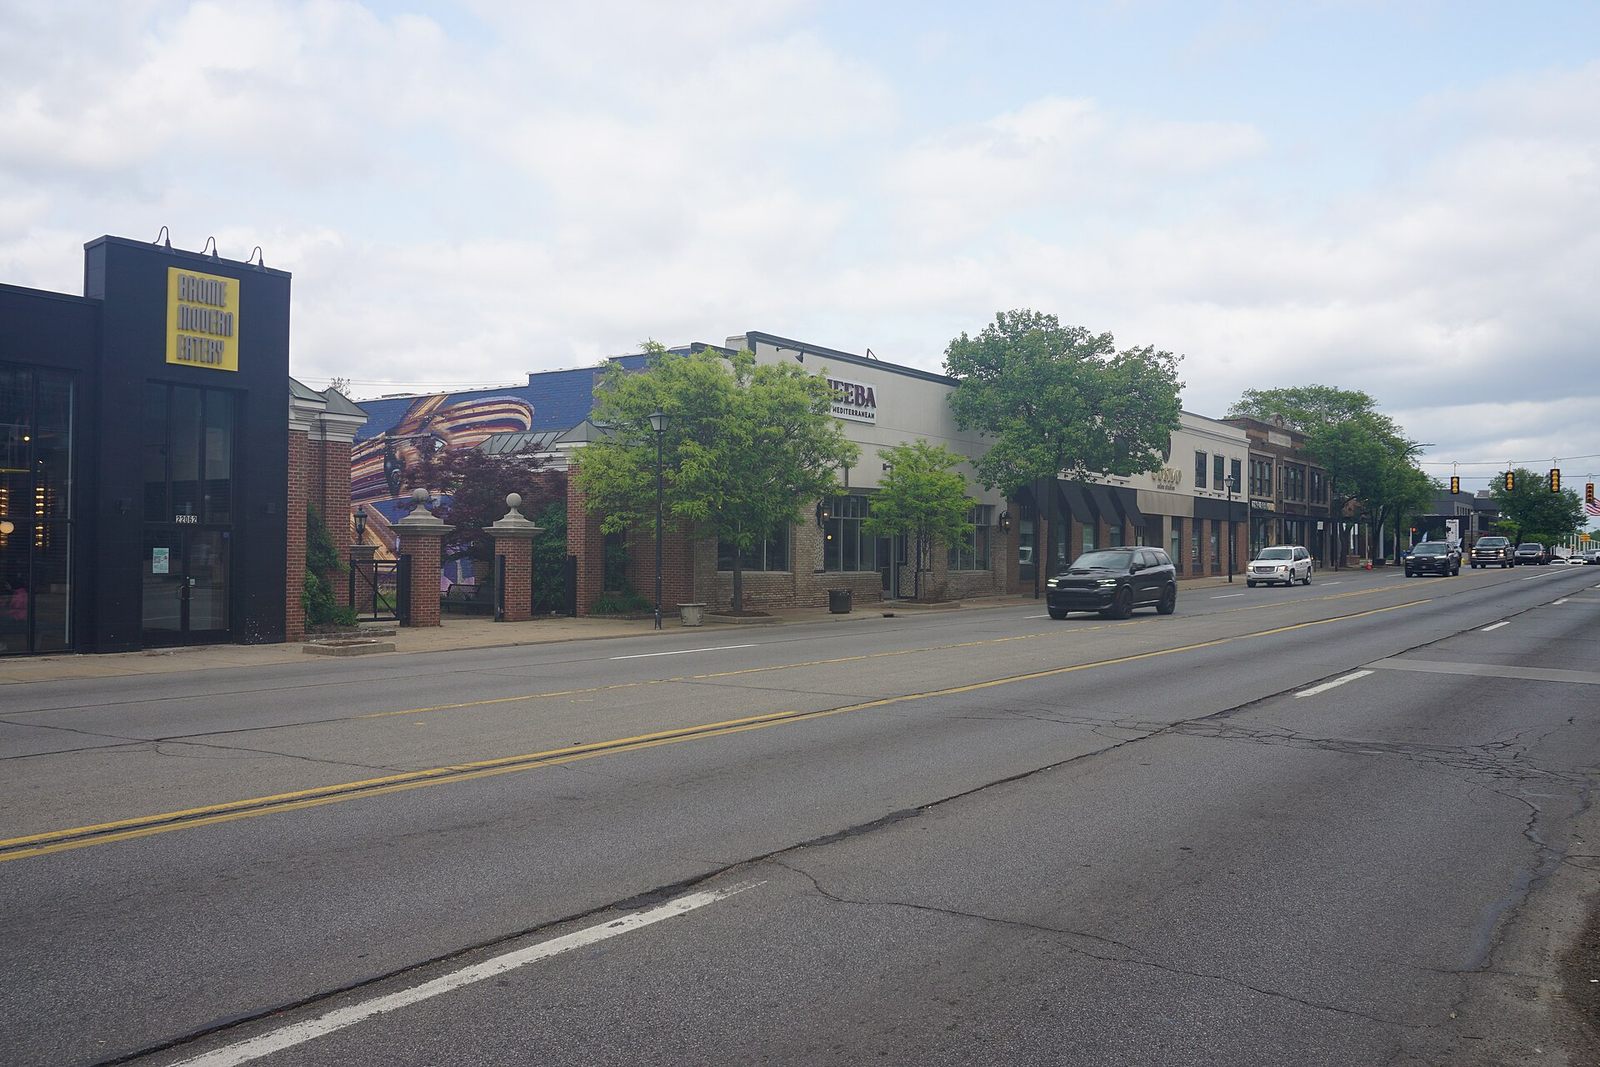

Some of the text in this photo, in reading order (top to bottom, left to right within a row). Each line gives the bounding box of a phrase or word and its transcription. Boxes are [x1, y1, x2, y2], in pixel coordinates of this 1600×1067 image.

[178, 274, 227, 307] BROME
[177, 304, 234, 337] MODERN
[177, 334, 224, 364] EATERY
[812, 376, 876, 409] EEBA
[833, 406, 875, 418] MEDITERRANEAN
